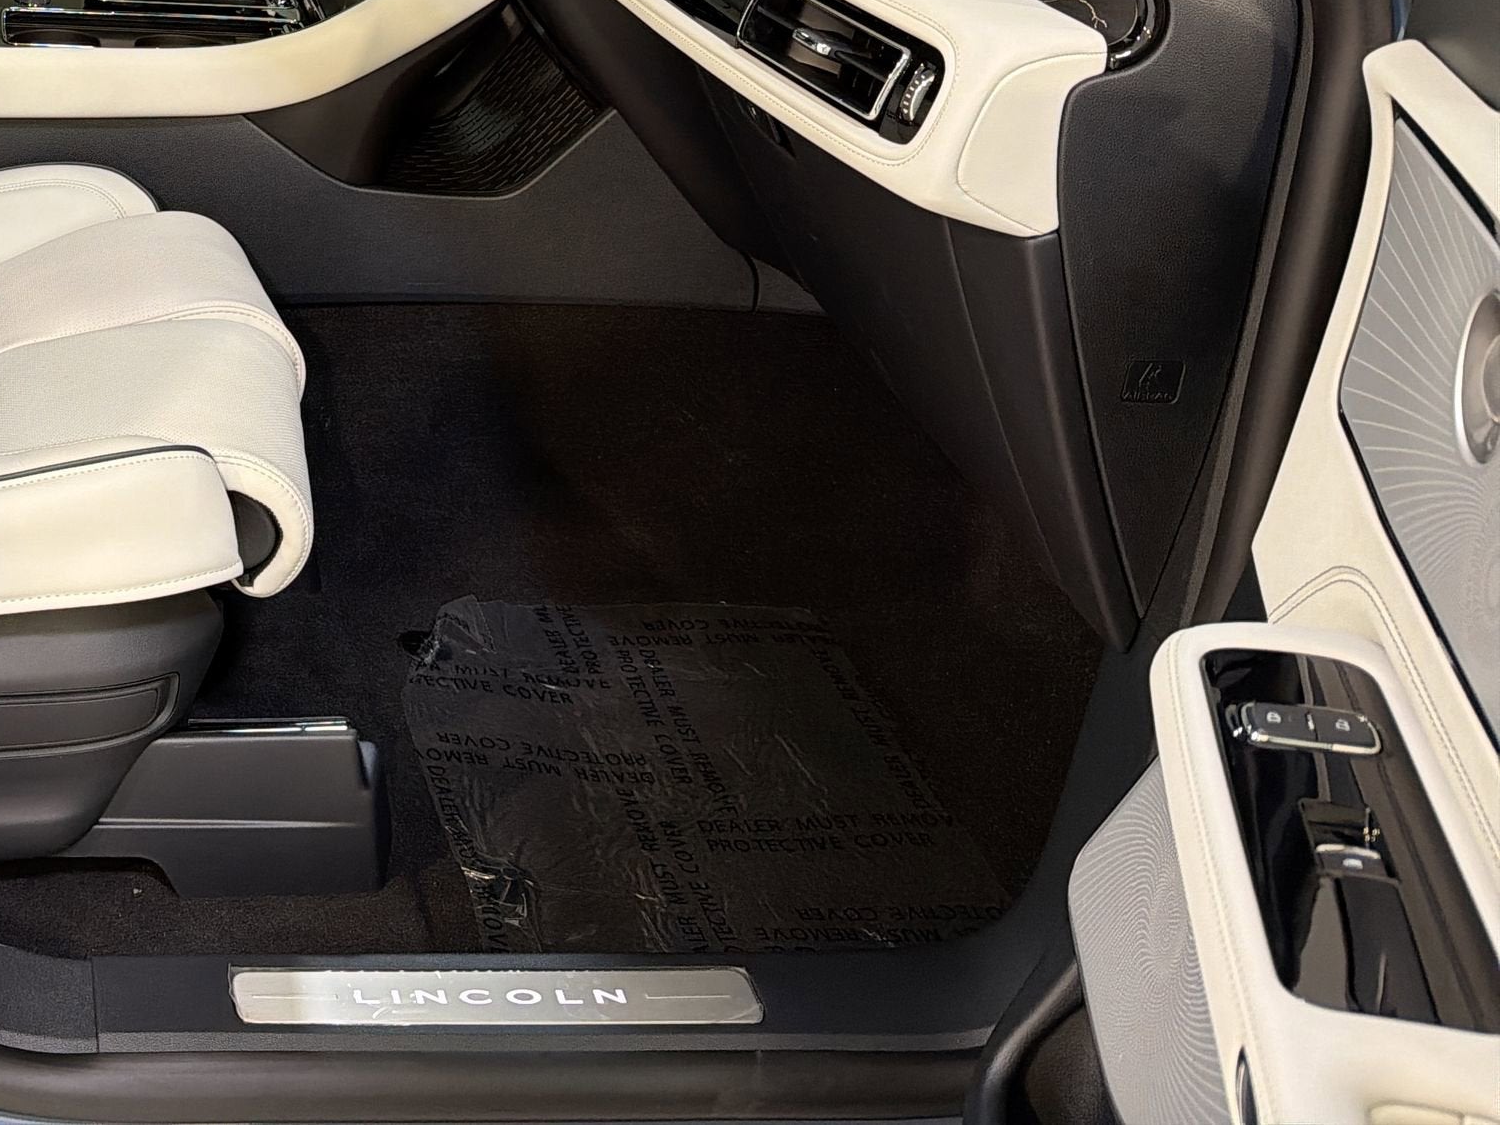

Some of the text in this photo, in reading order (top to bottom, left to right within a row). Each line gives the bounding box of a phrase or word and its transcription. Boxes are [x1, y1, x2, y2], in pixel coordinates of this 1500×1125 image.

[641, 618, 710, 632] COVER
[608, 634, 693, 647] REMOVE
[704, 633, 760, 645] MUST
[545, 629, 580, 675] DEALER
[502, 684, 574, 705] COVER
[616, 649, 694, 786] PROTECTIVE COVER
[639, 649, 740, 818] DEALER MUST REMOVE
[436, 731, 647, 767] PROTECTIVE COVER
[502, 757, 563, 778] MUST
[571, 766, 656, 785] DEALER
[615, 789, 661, 852] REMOVE
[697, 819, 784, 834] DEALER
[795, 813, 859, 832] MUST
[657, 820, 701, 874] COVER
[706, 832, 936, 853] PROTECTIVE COVER
[650, 861, 689, 905] MUST
[794, 906, 878, 921] COVER
[753, 926, 860, 942] REMOVE
[352, 988, 628, 1005] LINCOLN
